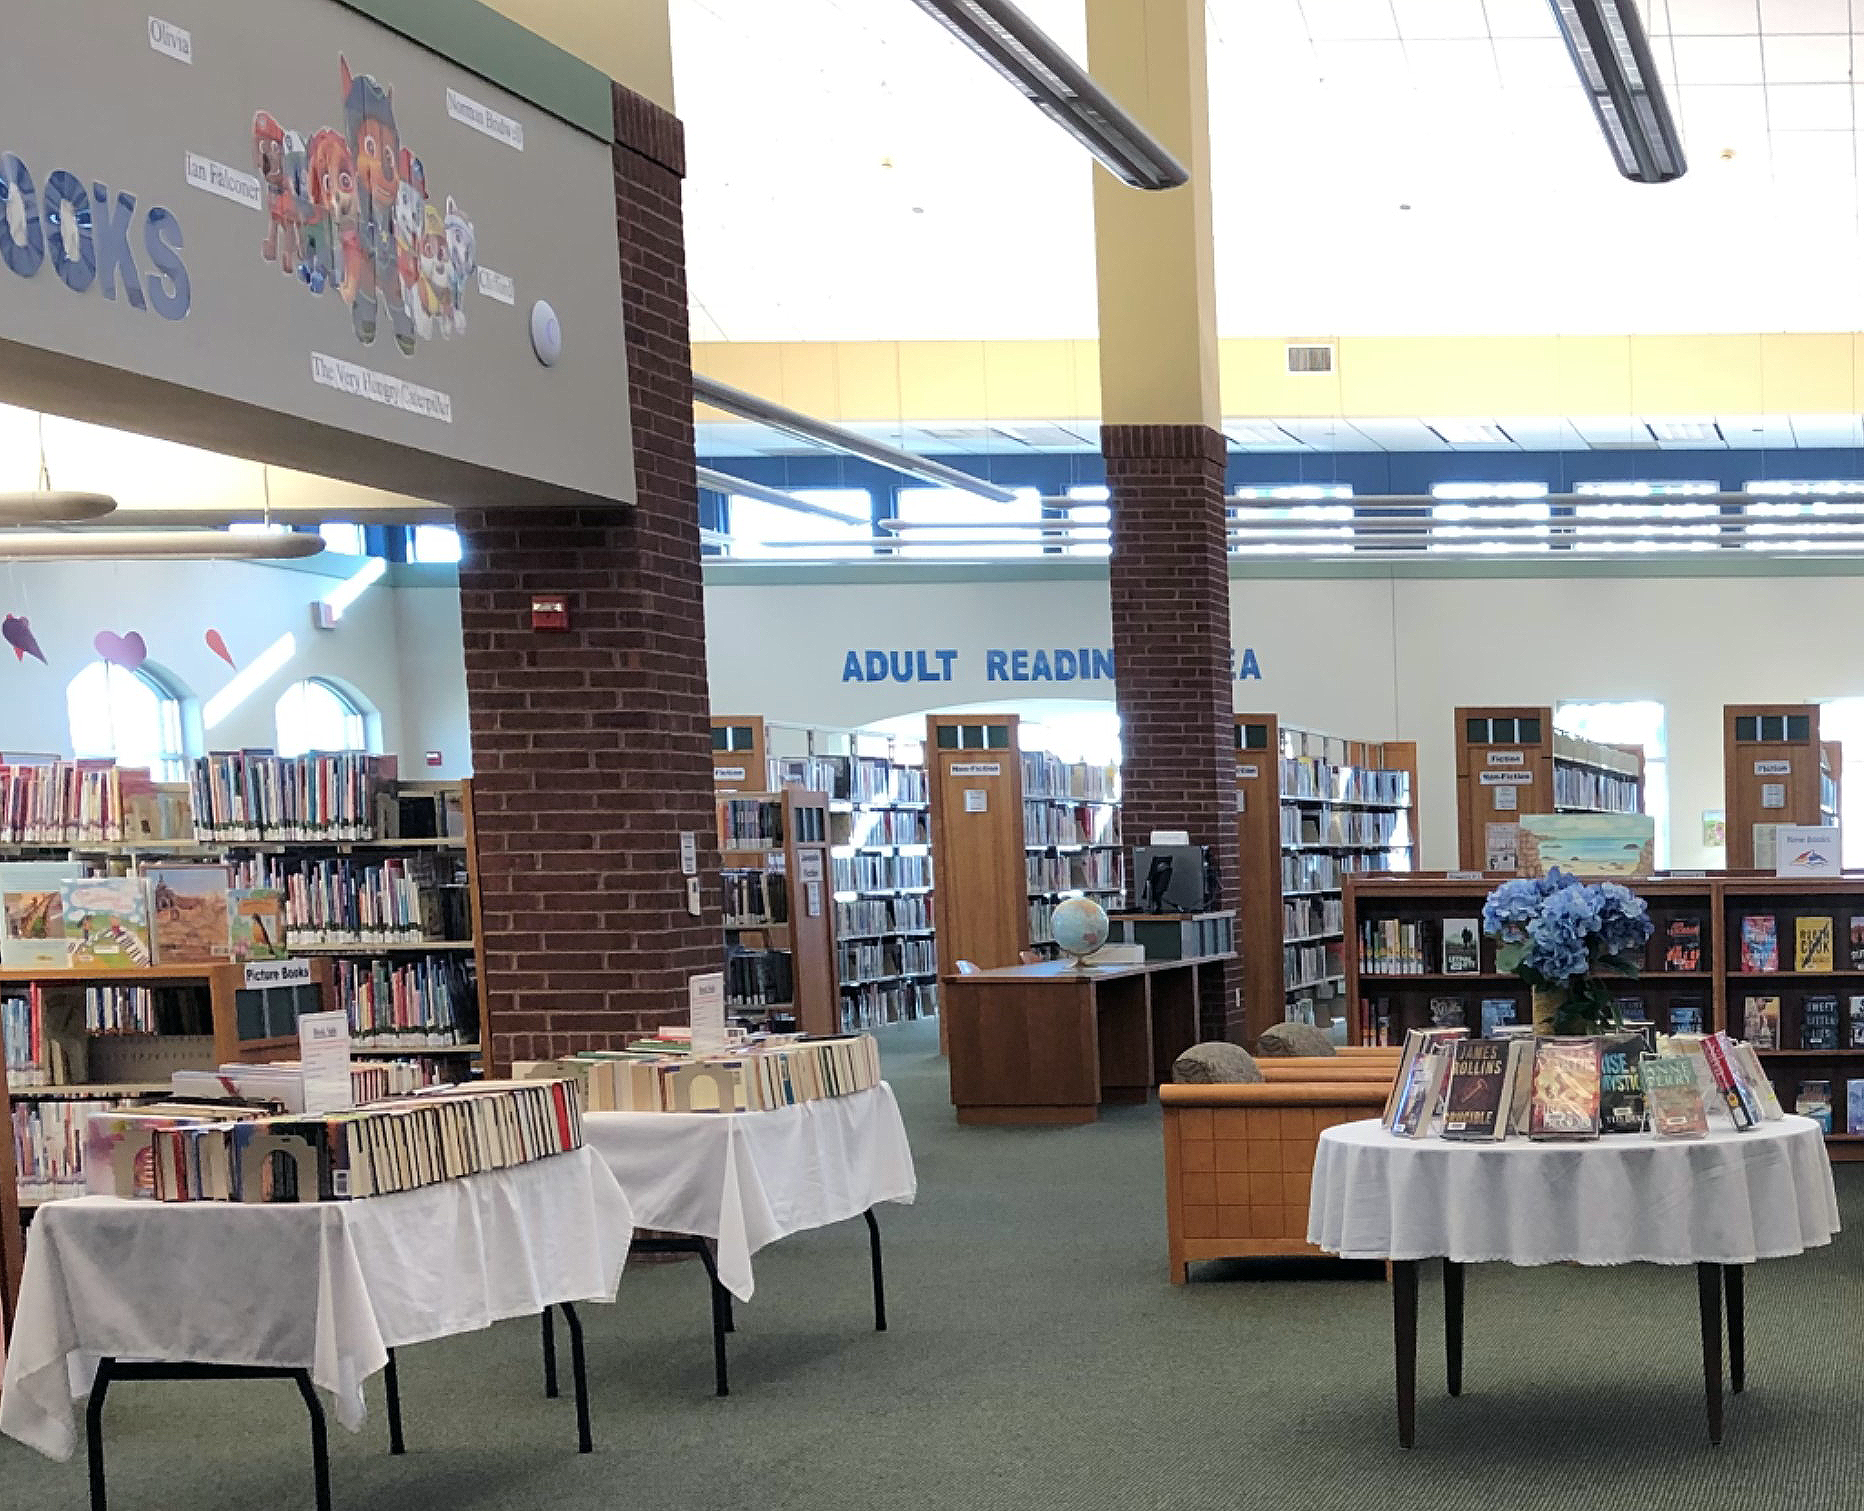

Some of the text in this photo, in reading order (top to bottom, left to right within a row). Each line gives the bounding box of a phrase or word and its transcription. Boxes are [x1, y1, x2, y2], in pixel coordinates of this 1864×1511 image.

[151, 19, 189, 54] Olivia
[188, 154, 260, 200] Ian Falconer
[0, 152, 191, 321] OOKS
[313, 356, 334, 379] The
[336, 362, 360, 392] Very
[842, 648, 1117, 683] ADULT READIN
[246, 966, 309, 982] Picture Books
[1461, 1045, 1498, 1059] JAMES
